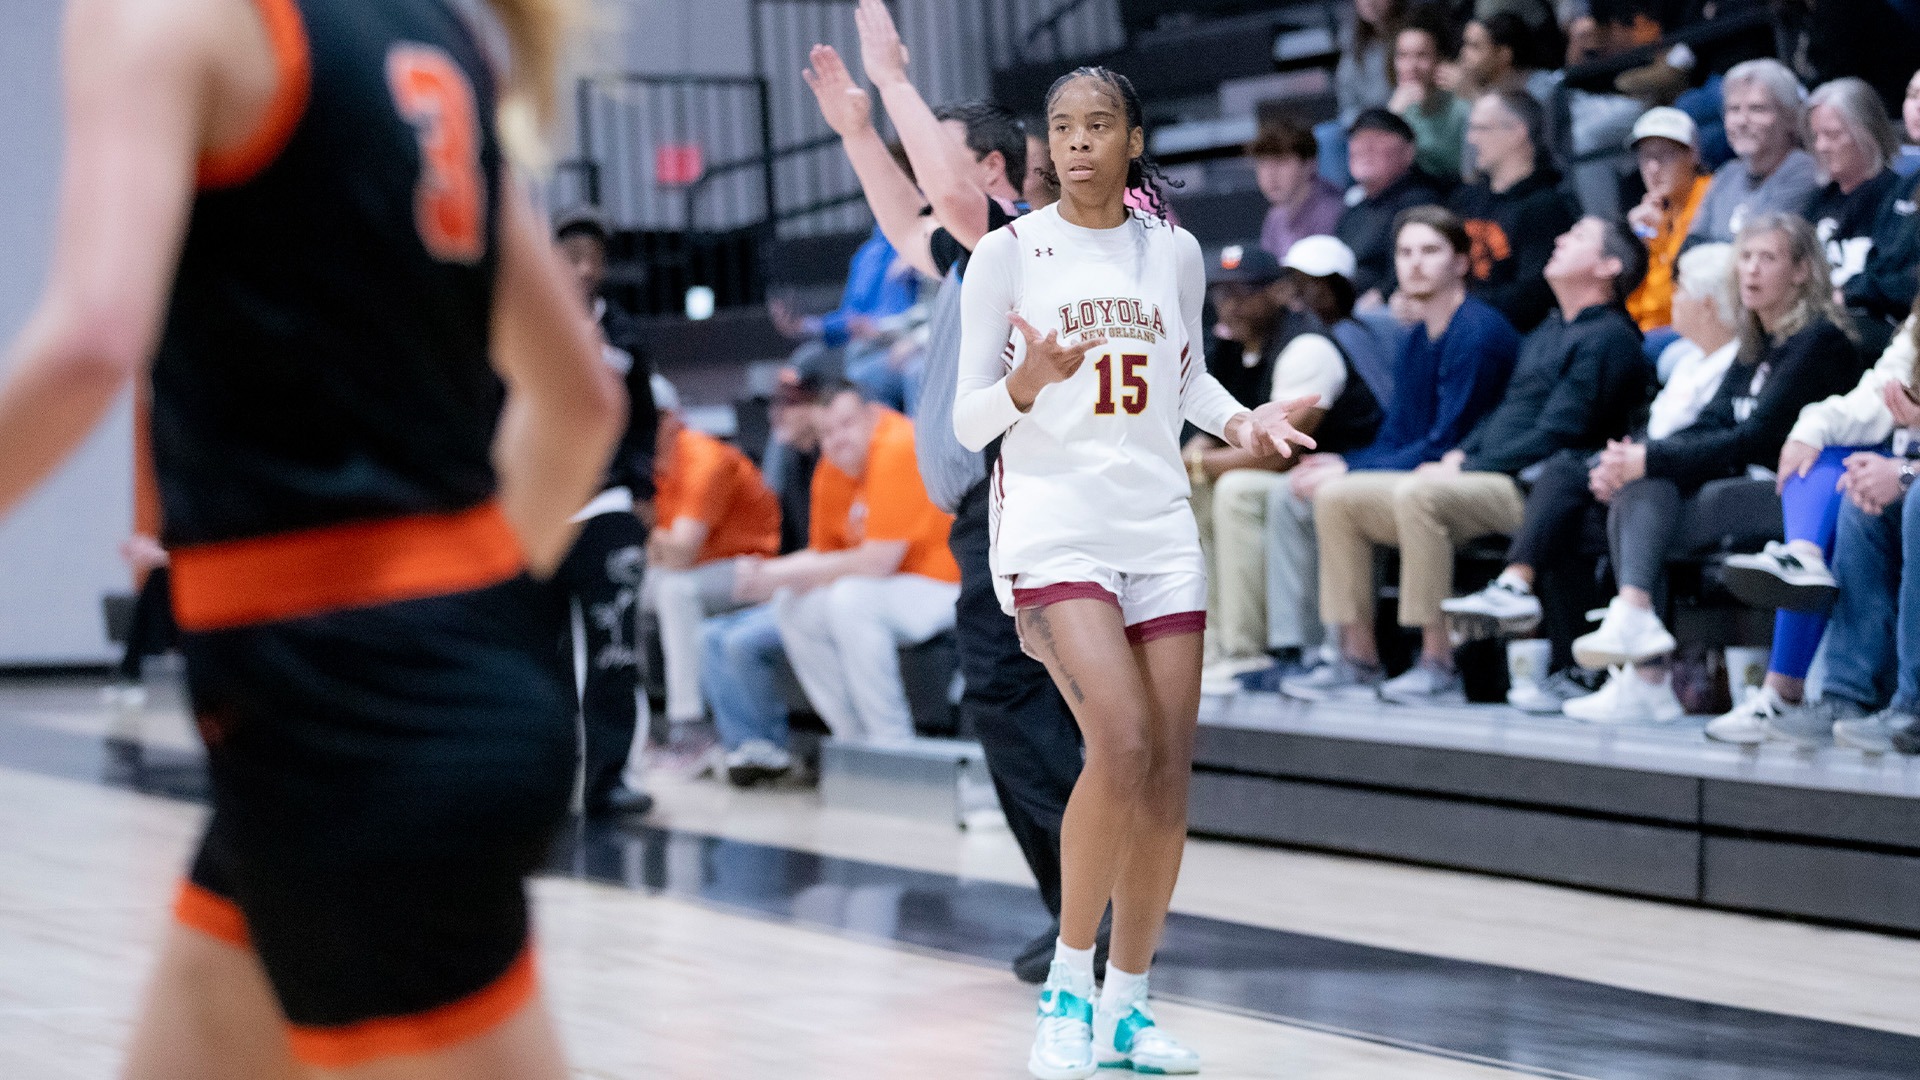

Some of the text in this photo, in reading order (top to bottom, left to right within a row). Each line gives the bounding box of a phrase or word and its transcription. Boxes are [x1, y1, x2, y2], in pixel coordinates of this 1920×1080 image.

[384, 41, 486, 264] 3
[1059, 297, 1166, 339] LOYOLA
[1081, 327, 1156, 344] NEW ORLEANS
[1094, 353, 1148, 415] 15
